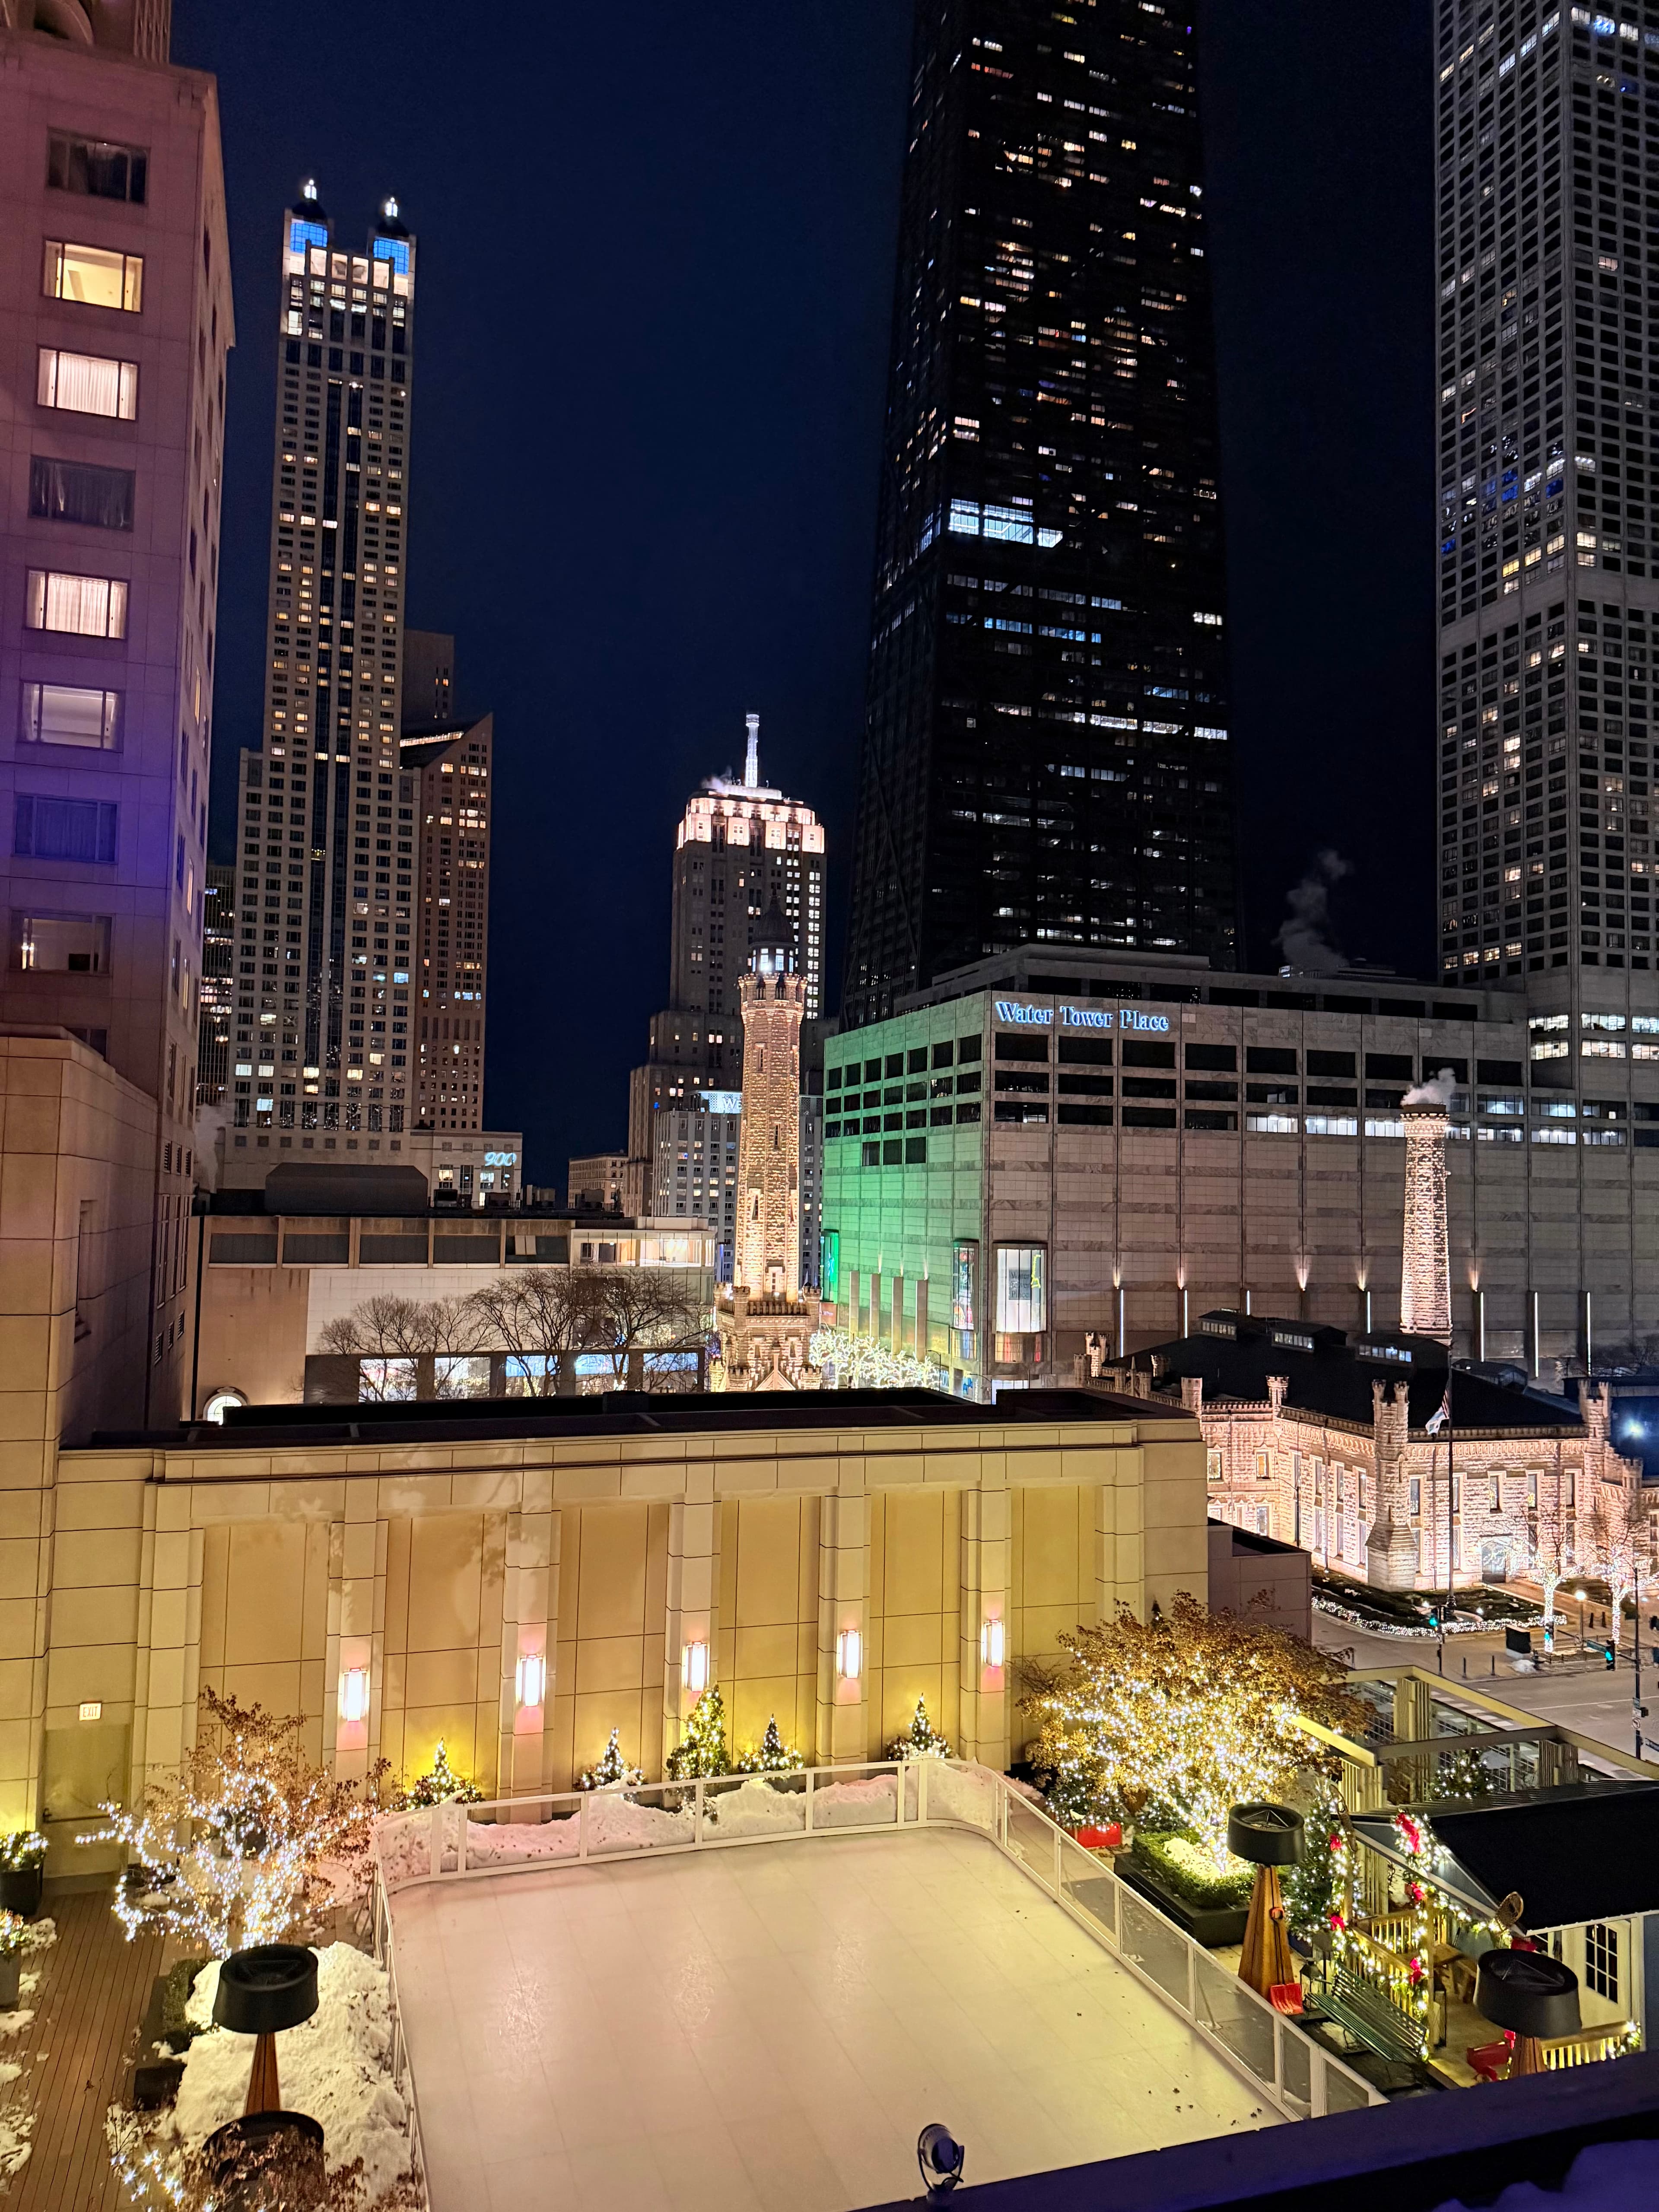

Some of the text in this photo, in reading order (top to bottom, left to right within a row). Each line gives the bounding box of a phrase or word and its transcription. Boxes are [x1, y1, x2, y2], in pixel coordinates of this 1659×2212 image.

[995, 1001, 1169, 1031] Water Tower Place
[485, 1152, 517, 1166] 900
[83, 1706, 98, 1717] EXIT
